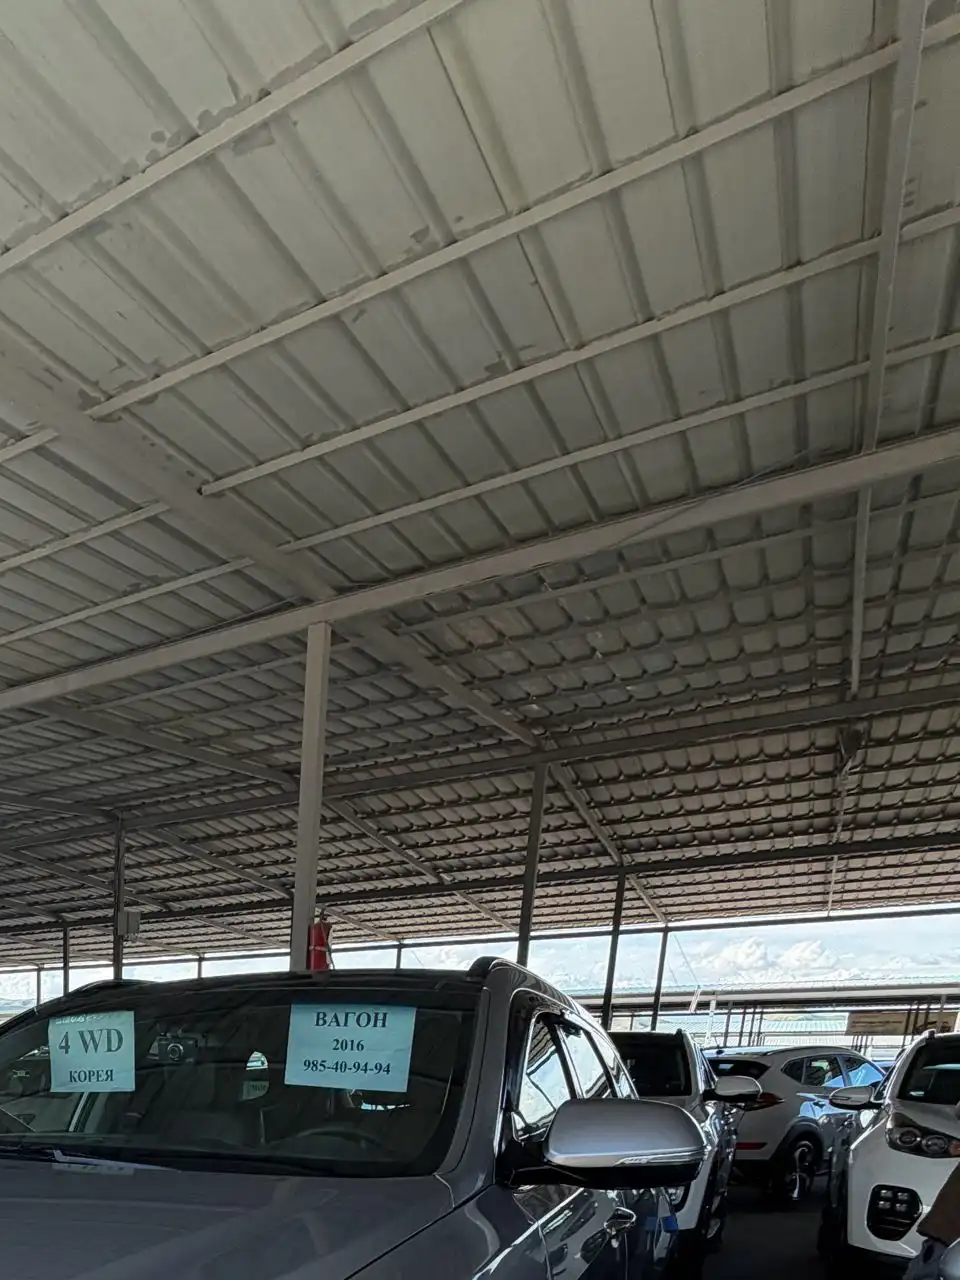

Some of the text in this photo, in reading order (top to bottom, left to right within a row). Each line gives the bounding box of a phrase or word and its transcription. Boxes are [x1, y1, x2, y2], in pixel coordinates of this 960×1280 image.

[314, 1011, 388, 1028] ВАГОН
[58, 1028, 124, 1055] 4 WD
[332, 1038, 365, 1052] 2016
[303, 1059, 391, 1075] 985-40-94-94
[68, 1069, 114, 1083] КОРЕЯ
